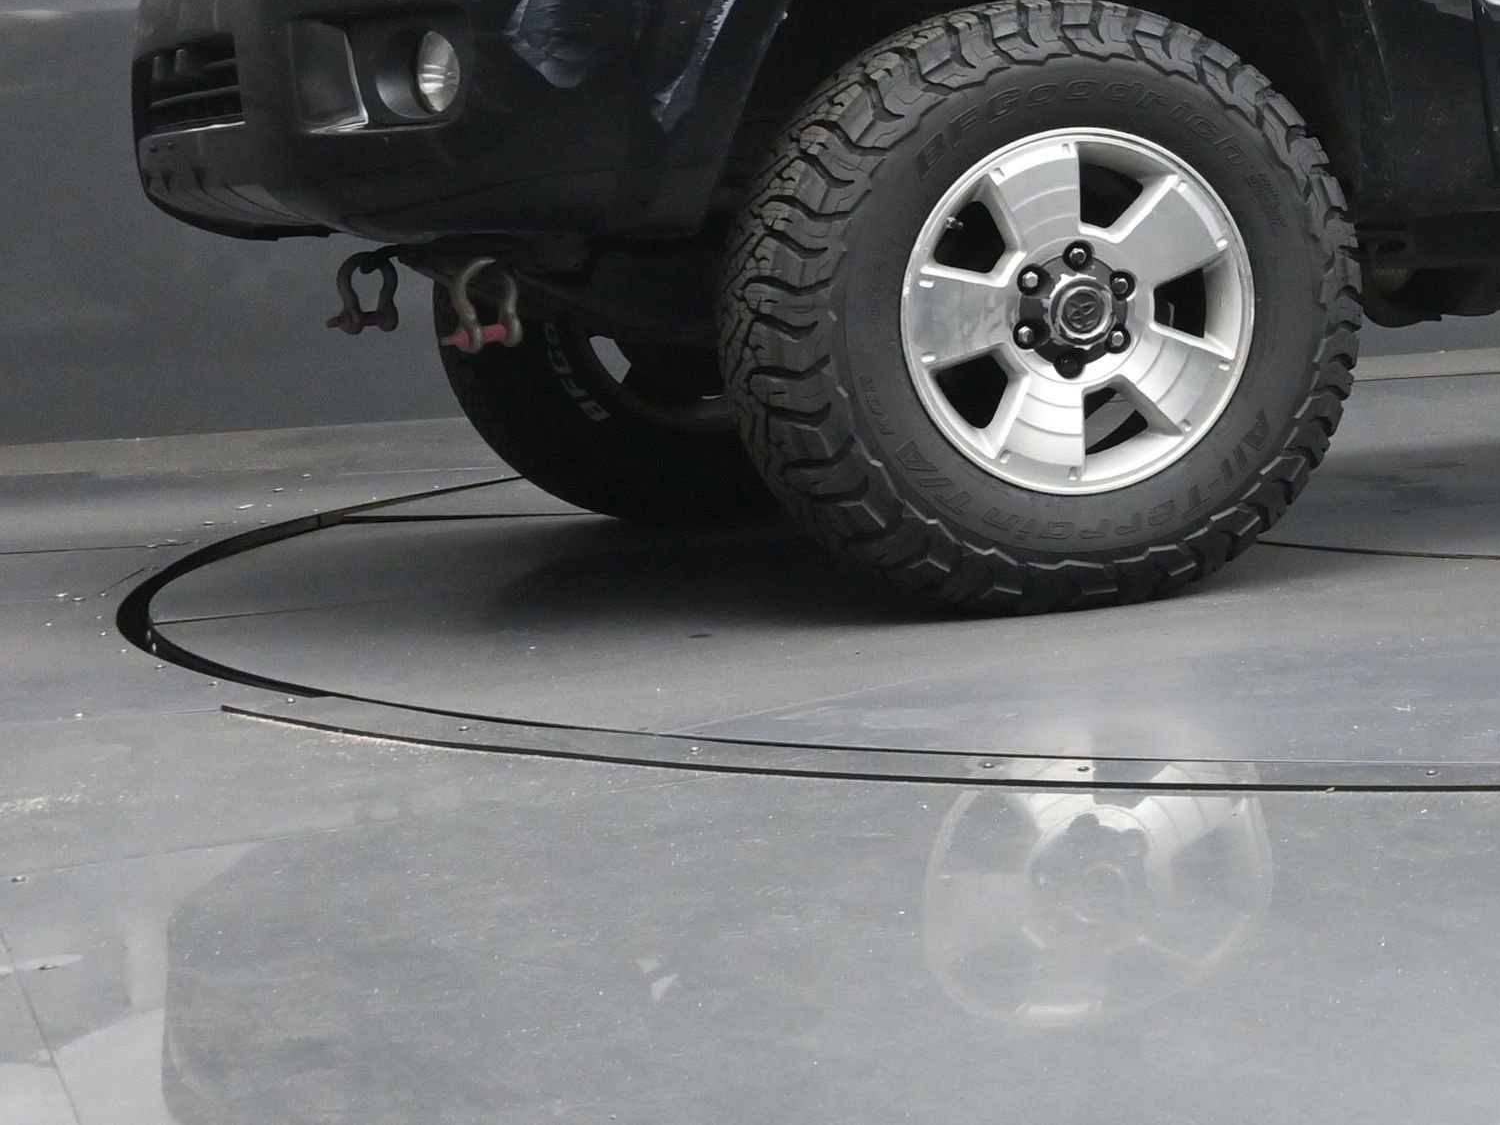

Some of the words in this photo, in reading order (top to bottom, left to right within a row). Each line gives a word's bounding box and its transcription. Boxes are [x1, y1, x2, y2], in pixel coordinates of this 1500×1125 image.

[916, 81, 1248, 177] BFGoodrich
[896, 442, 972, 516] T/A
[983, 412, 1270, 540] All-Terrain
